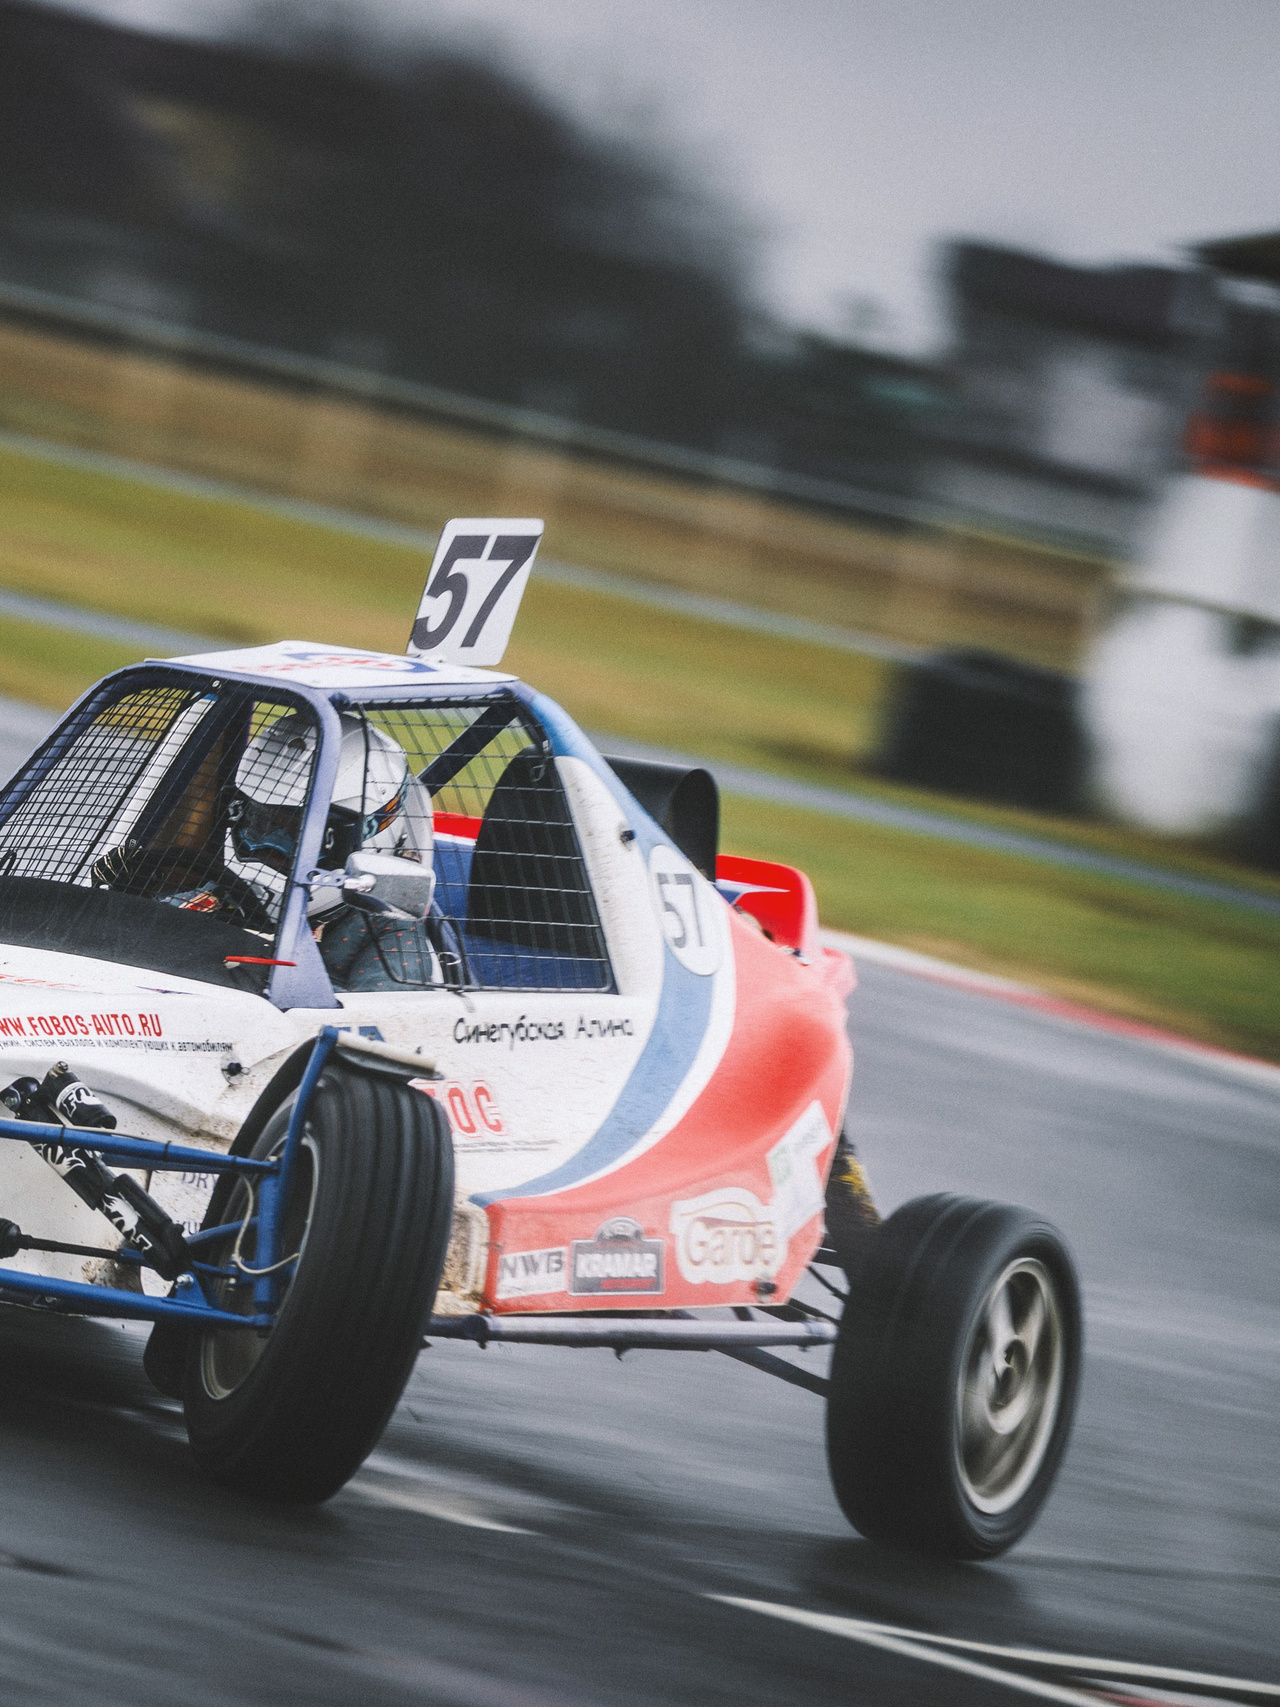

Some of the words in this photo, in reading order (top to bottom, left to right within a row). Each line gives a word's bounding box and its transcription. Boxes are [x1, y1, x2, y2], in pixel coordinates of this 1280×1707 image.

[412, 533, 542, 650] 57
[657, 873, 704, 949] 57
[24, 1039, 56, 1048] систем
[501, 1250, 563, 1280] NWB
